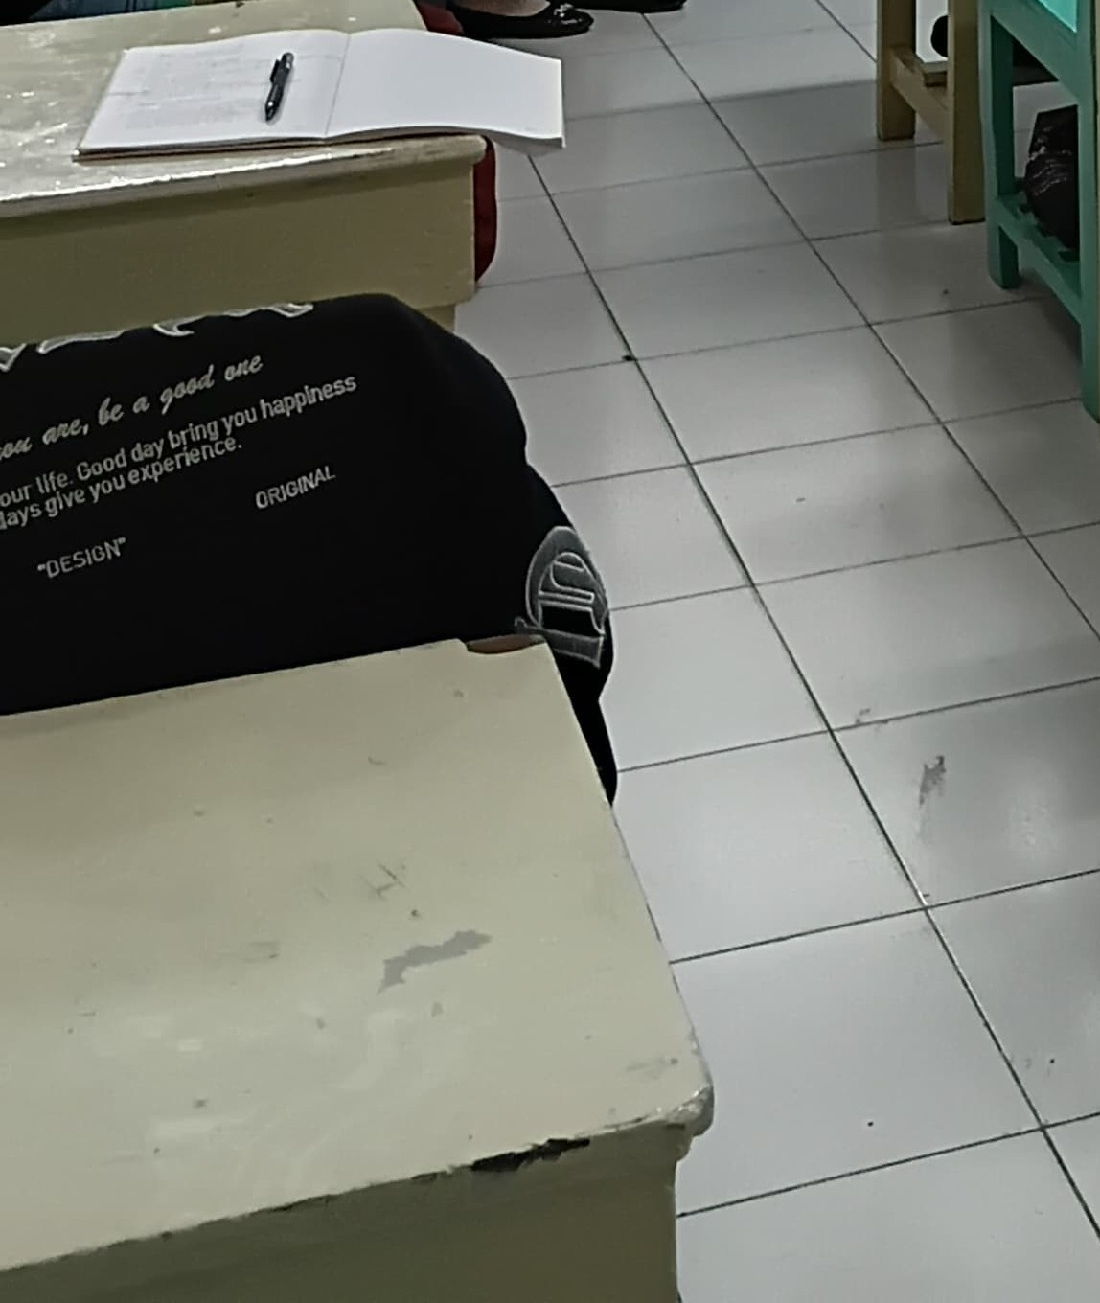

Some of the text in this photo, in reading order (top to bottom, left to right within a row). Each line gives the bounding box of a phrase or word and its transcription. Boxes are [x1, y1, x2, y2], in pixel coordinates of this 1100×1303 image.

[98, 396, 125, 426] be
[132, 396, 150, 413] a
[160, 363, 216, 415] good
[223, 354, 264, 381] one
[77, 447, 127, 482] Good
[130, 438, 165, 463] day
[168, 422, 219, 450] bring
[220, 407, 259, 437] you
[259, 375, 357, 418] happiness
[44, 488, 86, 518] give
[88, 474, 126, 503] you
[255, 464, 337, 510] ORIGINAL
